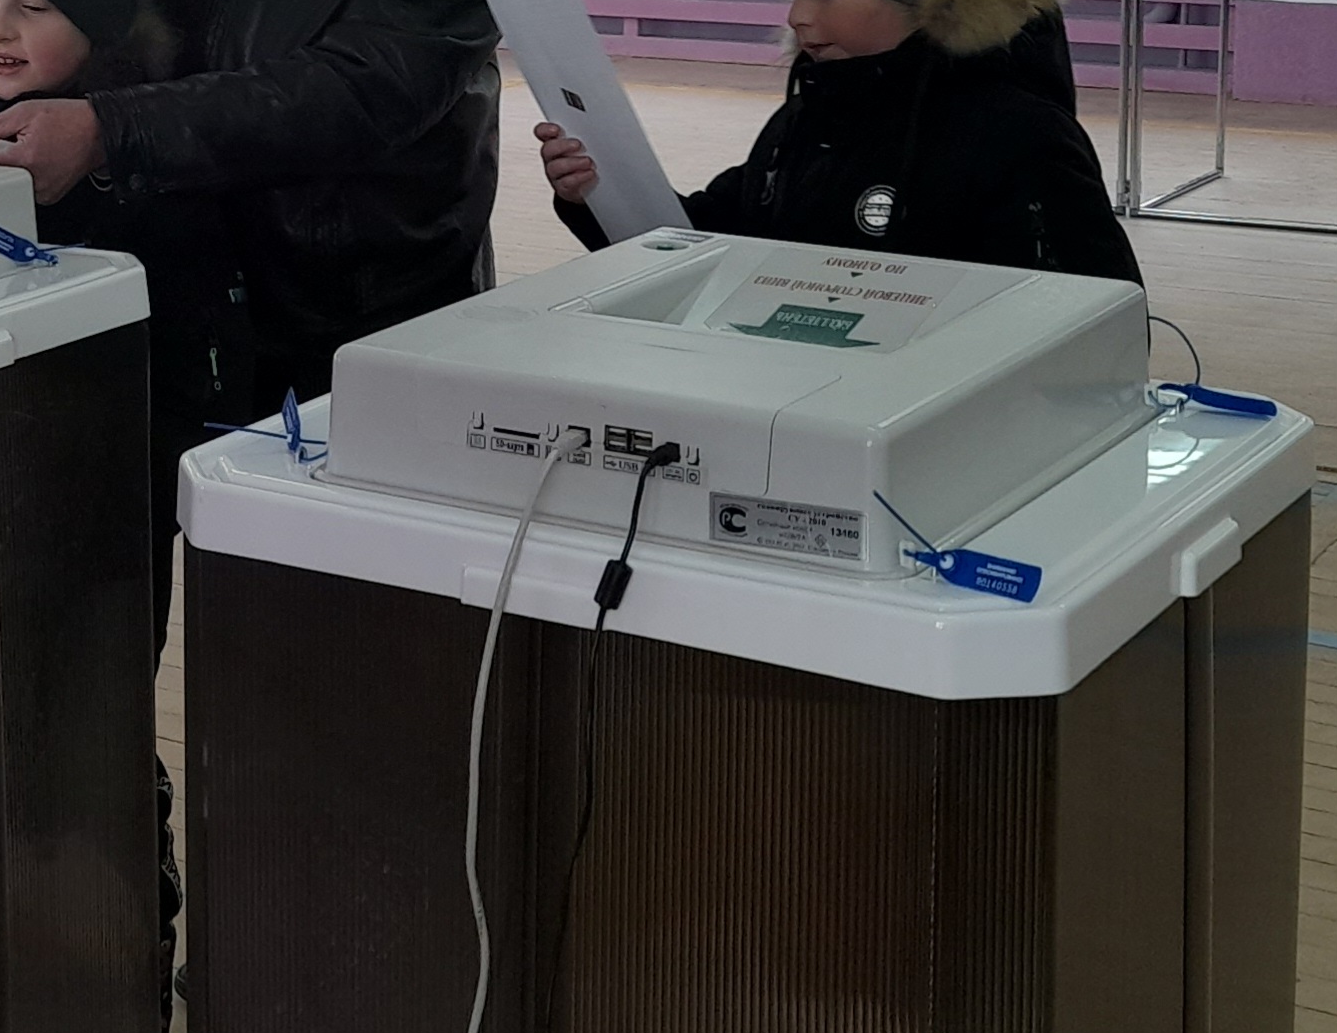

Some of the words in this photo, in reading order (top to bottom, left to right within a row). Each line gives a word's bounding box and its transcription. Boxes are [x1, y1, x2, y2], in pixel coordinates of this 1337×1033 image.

[821, 256, 882, 274] ОДНОМУ
[884, 264, 908, 275] ПО
[790, 278, 863, 297] СТОРОНОЙ
[863, 287, 933, 306] ЛИЦЕВОЙ
[775, 311, 854, 331] БЮЛЛЕТЕНЬ
[618, 460, 639, 472] USB
